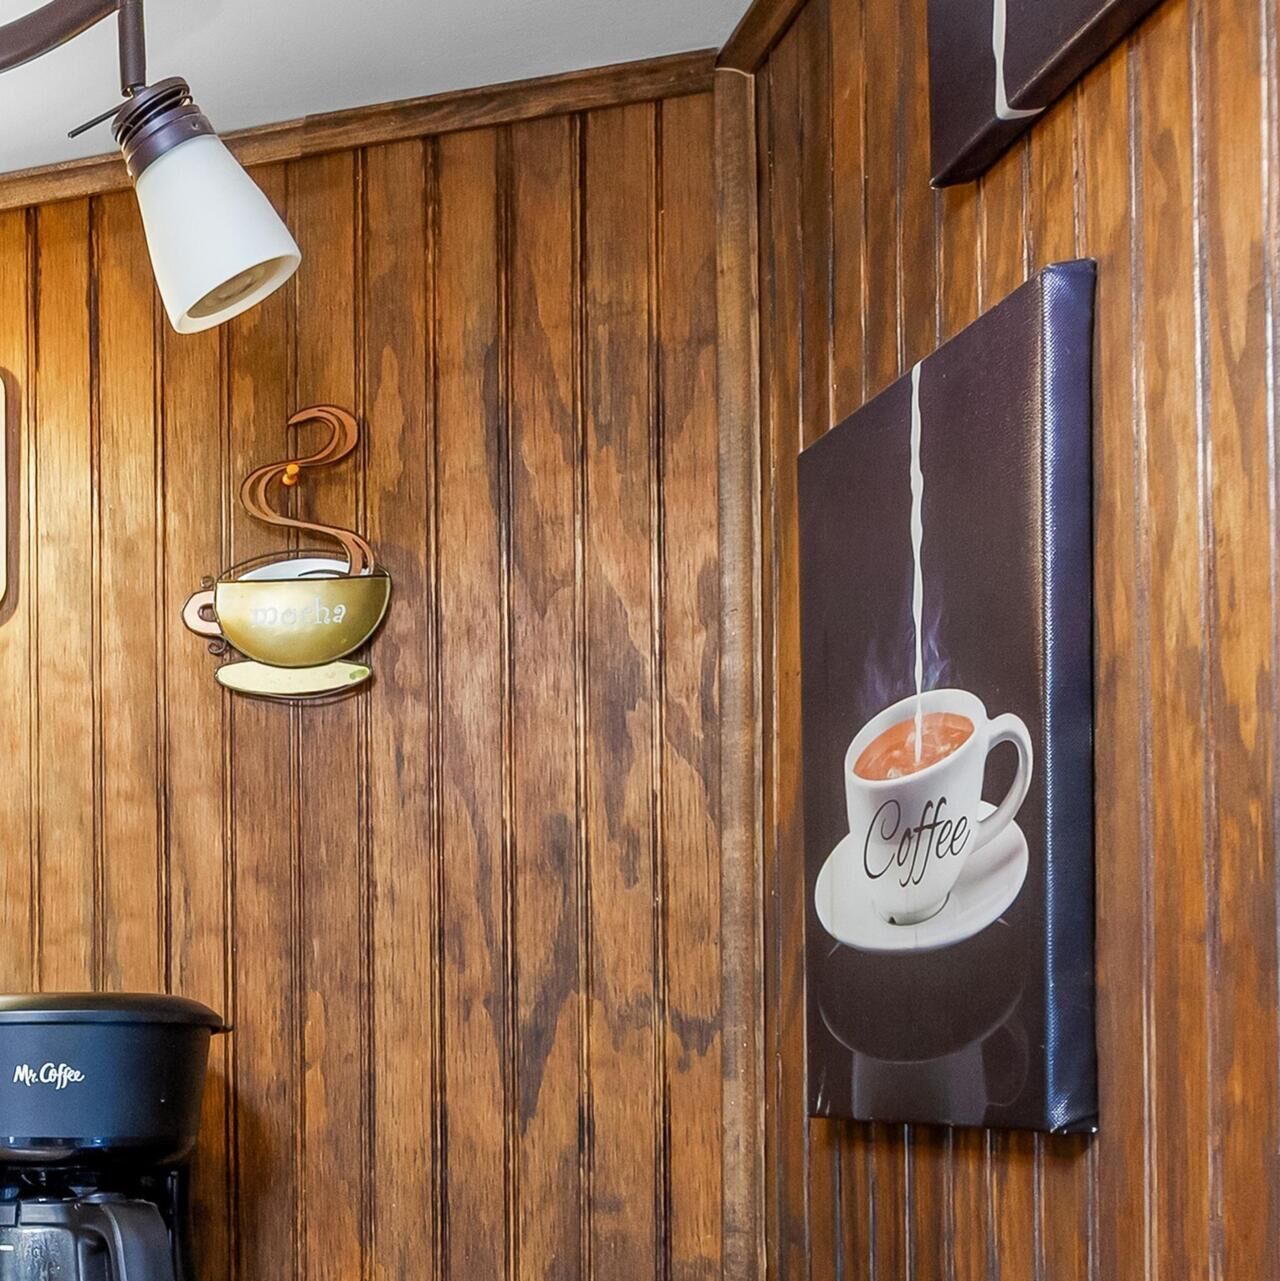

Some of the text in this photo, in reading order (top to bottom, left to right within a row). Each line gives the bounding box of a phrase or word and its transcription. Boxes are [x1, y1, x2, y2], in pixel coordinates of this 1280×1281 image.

[863, 796, 971, 888] Coffee
[13, 1062, 86, 1090] Mr. Coffee
